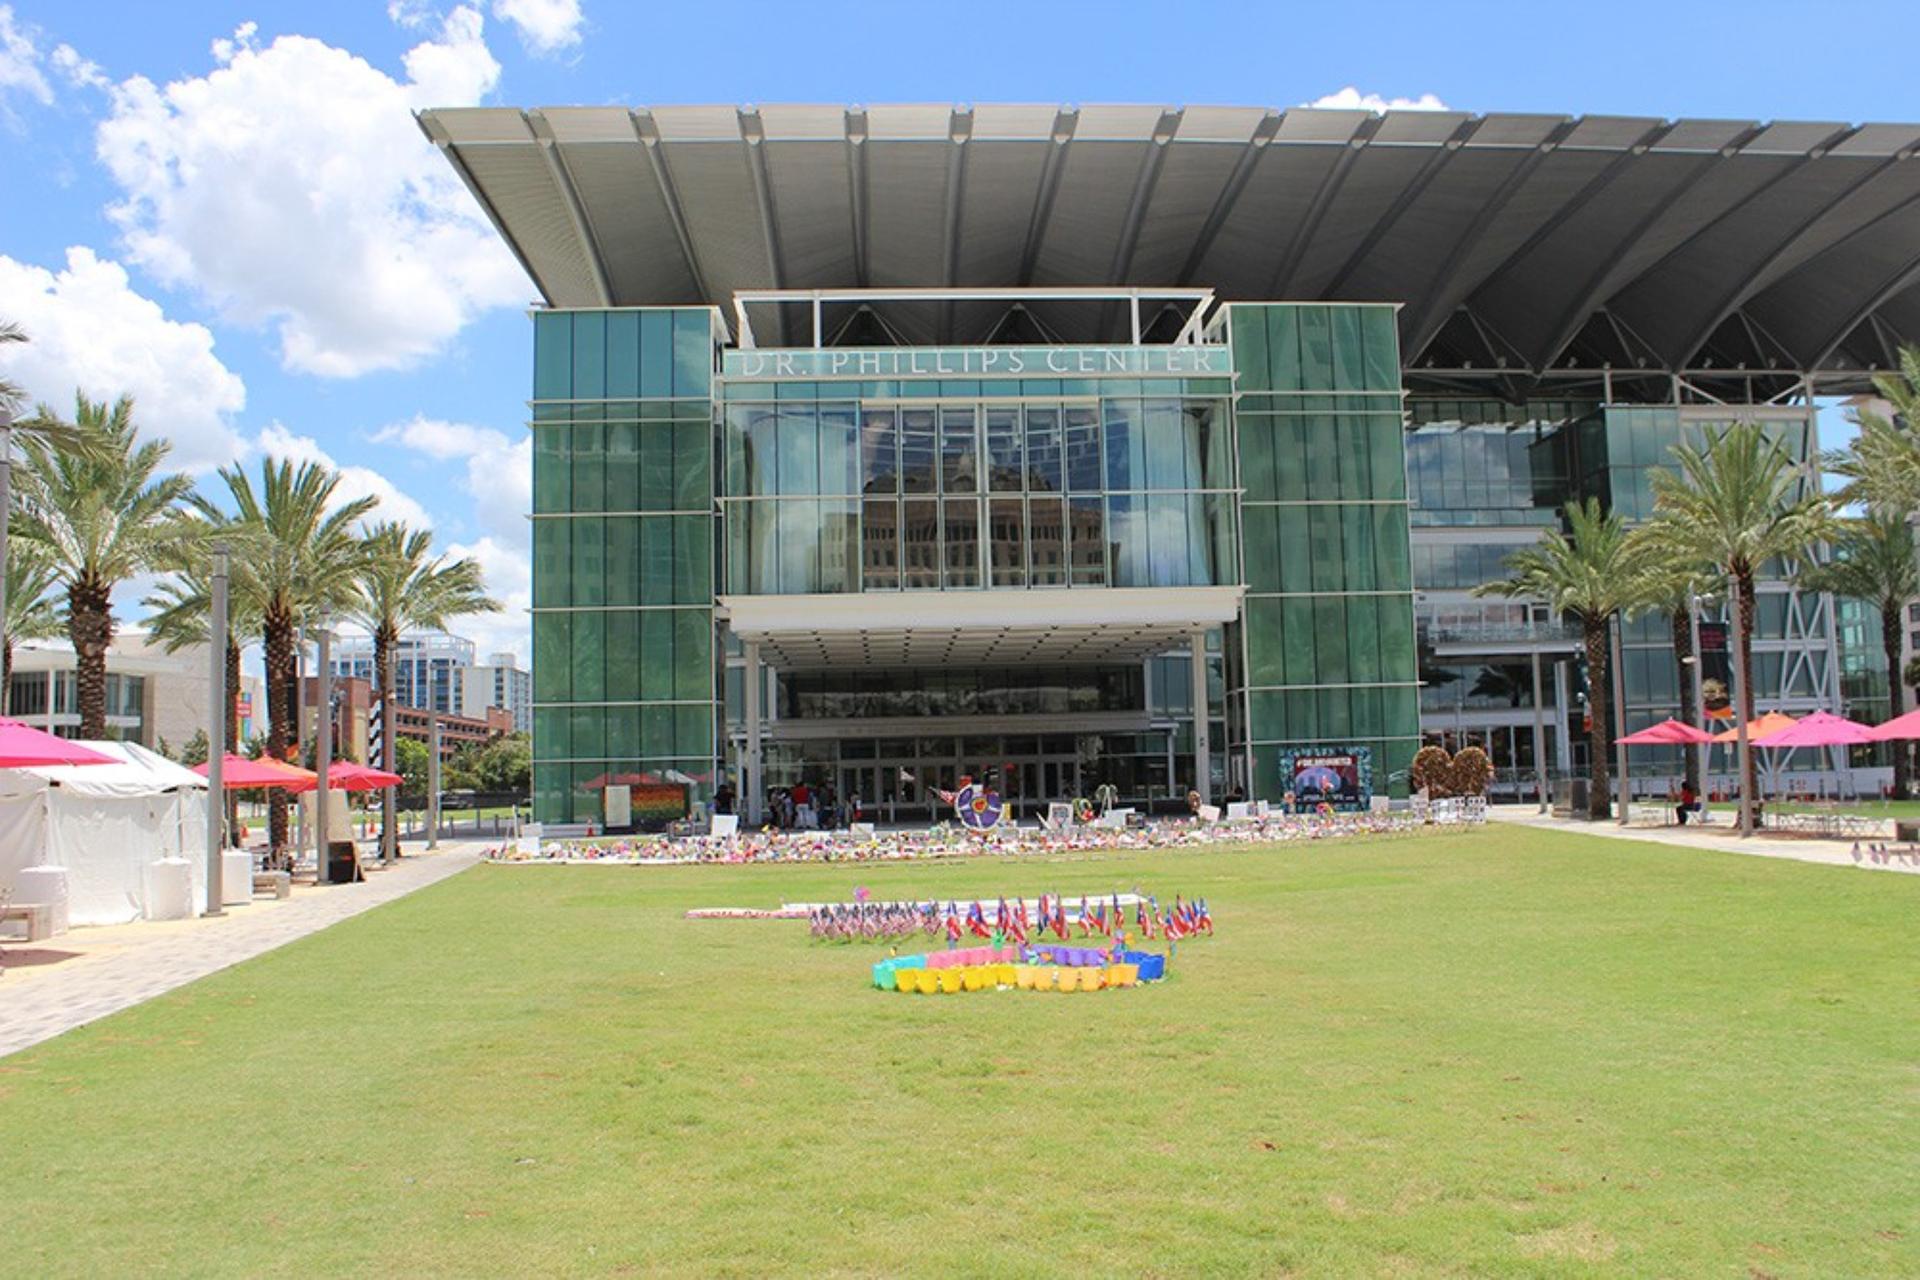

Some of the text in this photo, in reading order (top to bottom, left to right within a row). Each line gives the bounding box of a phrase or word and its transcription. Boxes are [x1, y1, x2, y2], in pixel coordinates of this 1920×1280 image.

[741, 349, 1212, 377] DR. PHILLIPS CENTER
